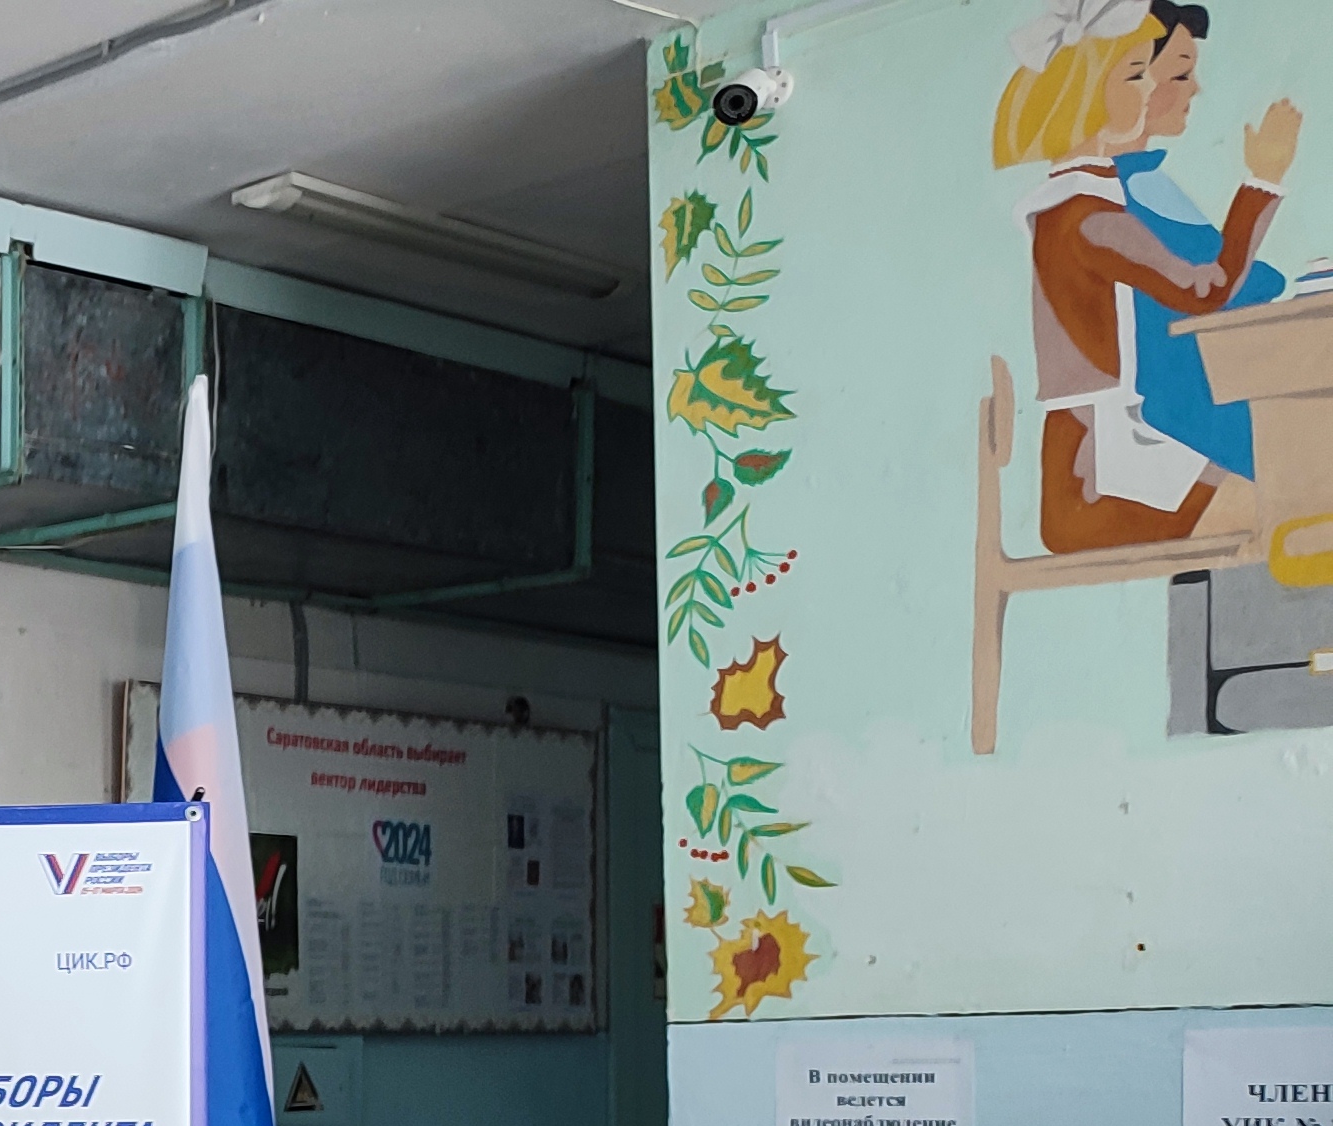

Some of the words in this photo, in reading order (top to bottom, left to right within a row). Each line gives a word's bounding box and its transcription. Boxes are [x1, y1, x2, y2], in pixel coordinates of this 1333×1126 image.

[267, 726, 350, 754] Саратовская
[353, 738, 403, 760] область
[407, 744, 466, 767] выбирает
[311, 771, 356, 794] вектор
[359, 778, 426, 798] лидерства
[382, 820, 432, 867] 2024
[56, 951, 133, 974] ЦИК.РФ
[808, 1069, 821, 1084] В
[827, 1071, 935, 1085] помещении
[836, 1096, 906, 1108] ведется
